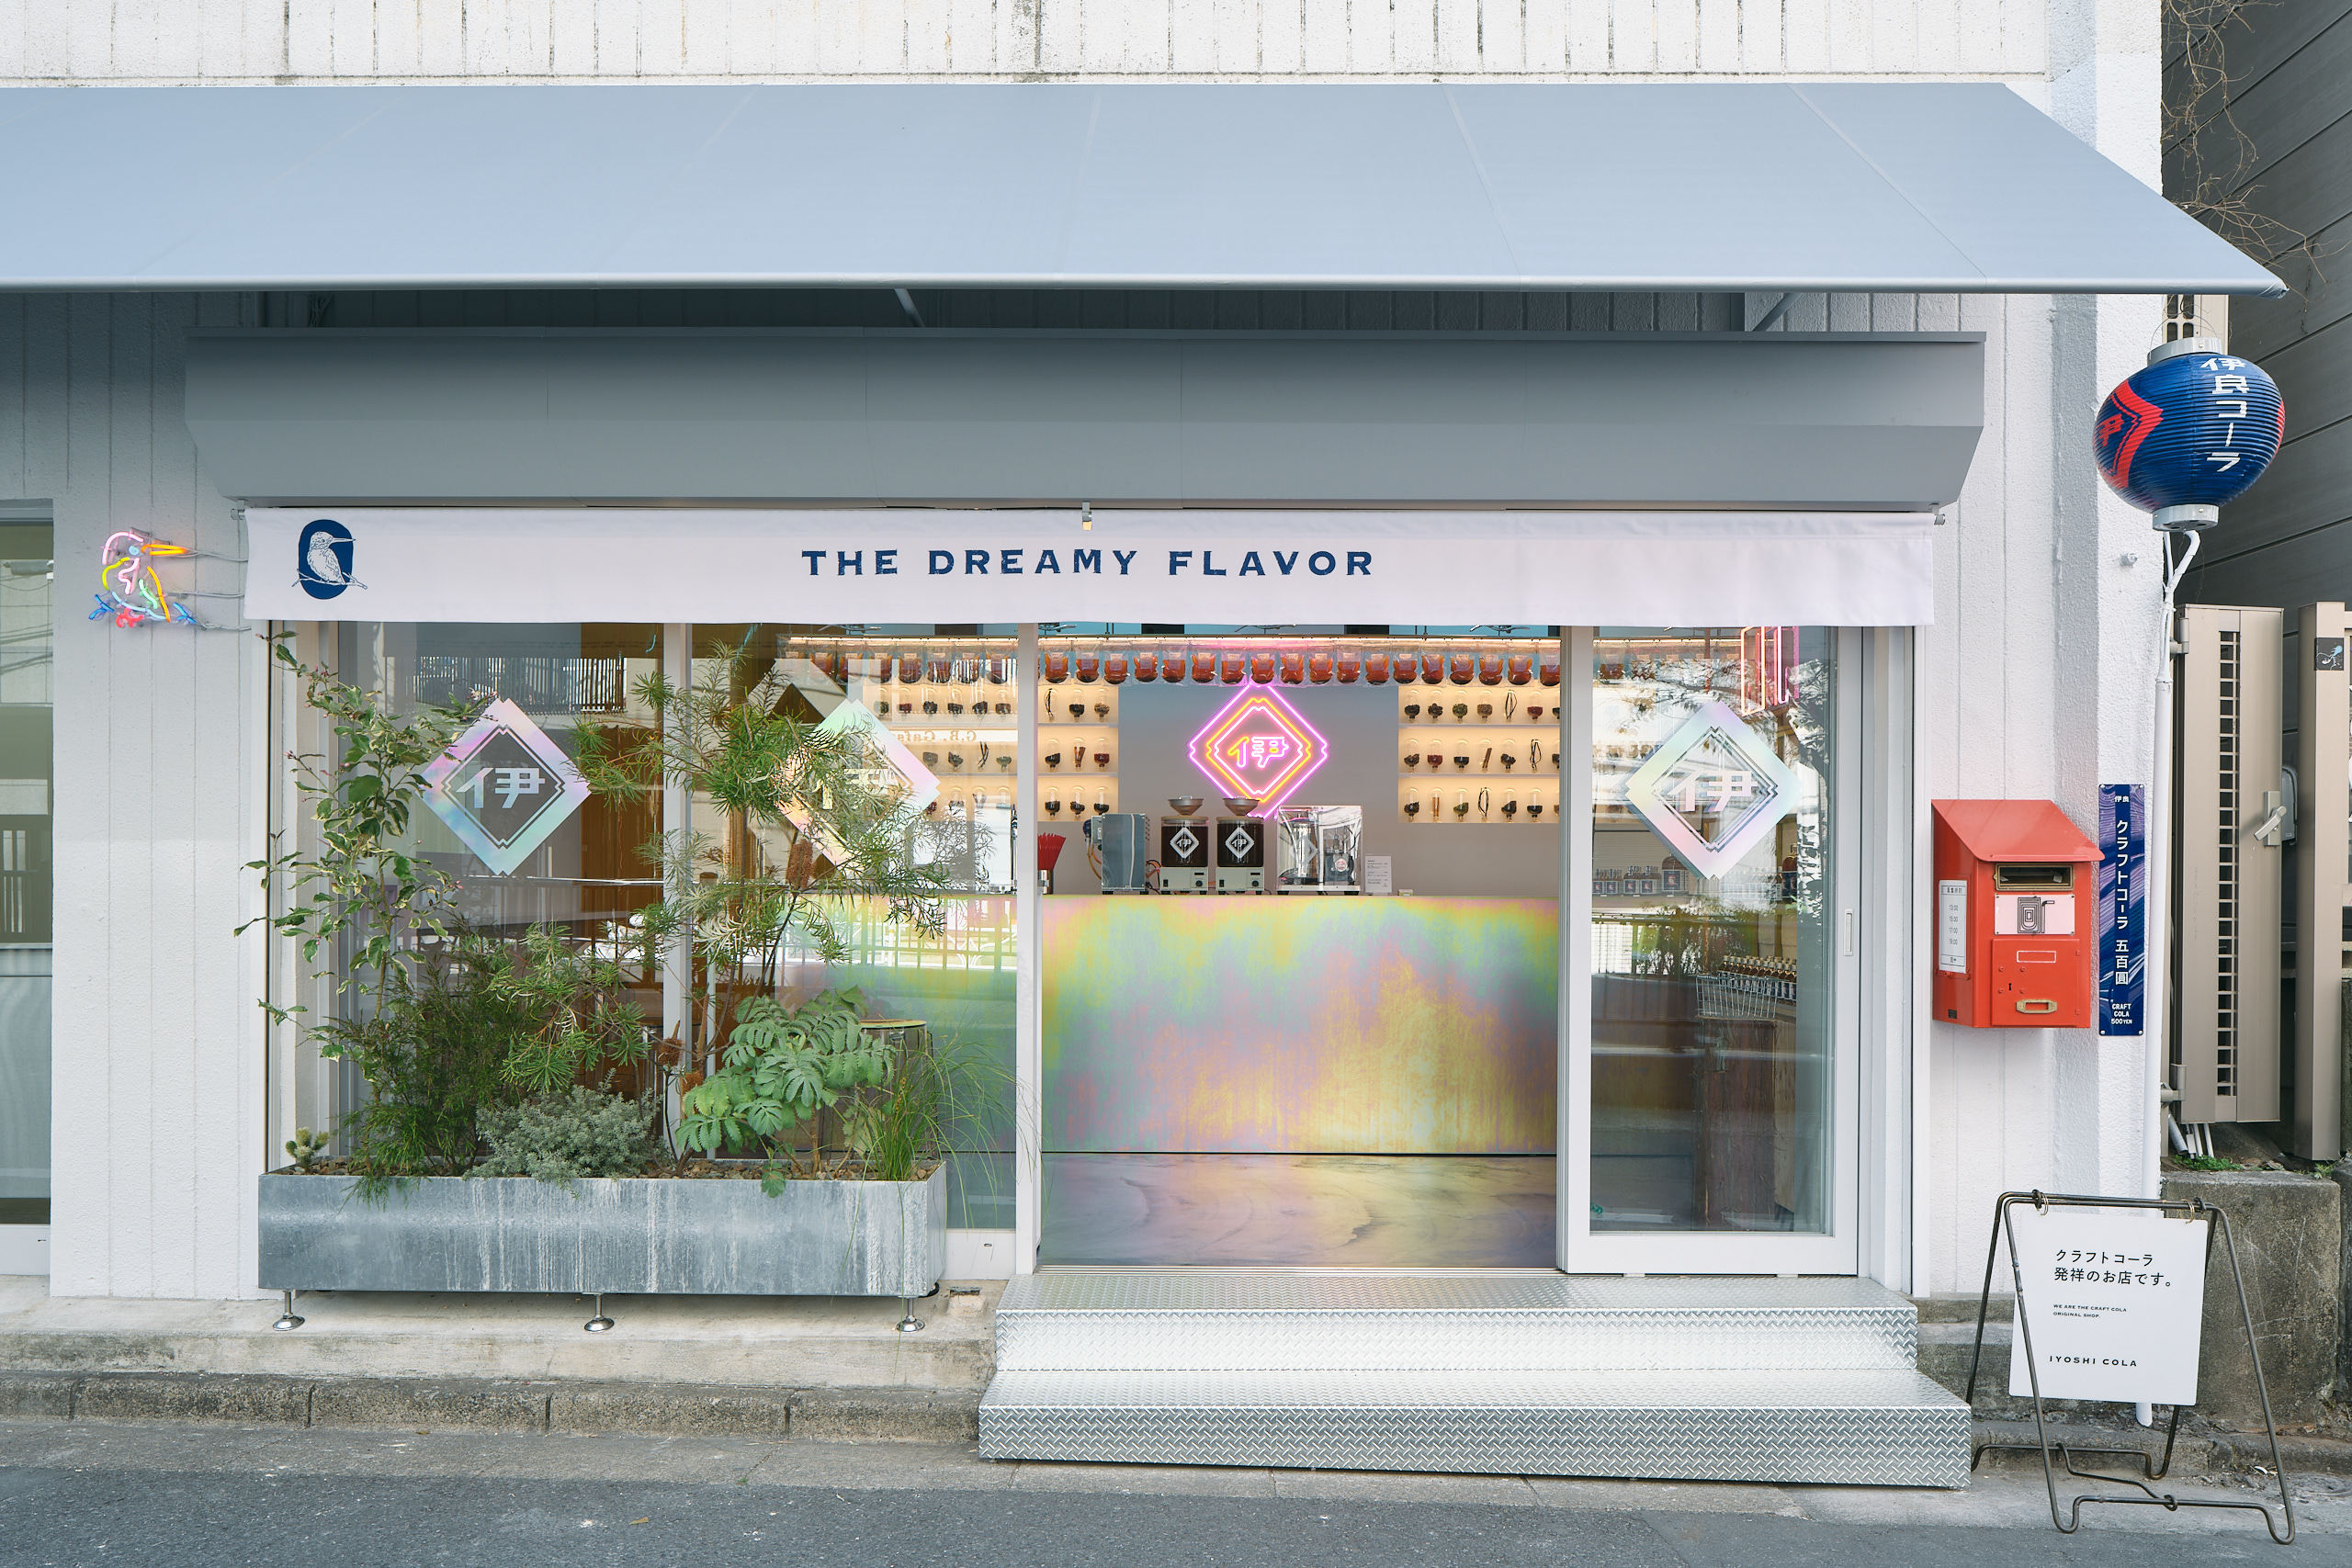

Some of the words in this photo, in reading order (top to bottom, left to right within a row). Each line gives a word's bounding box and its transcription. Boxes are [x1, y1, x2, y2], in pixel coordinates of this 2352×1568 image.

[801, 550, 898, 576] THE
[928, 548, 1137, 575] DREAMY
[1168, 550, 1373, 577] FLAVOR
[1227, 735, 1289, 769] 伊
[455, 765, 547, 810] 伊
[1667, 770, 1759, 813] 伊
[2116, 819, 2129, 930] クラフトコーラ
[2115, 940, 2129, 986] 五百圓
[2055, 1249, 2154, 1267] クラフトコーラ
[2053, 1268, 2172, 1288] 発祥のお店です。
[2050, 1355, 2097, 1365] IYOSHI
[2102, 1359, 2137, 1367] COLA
